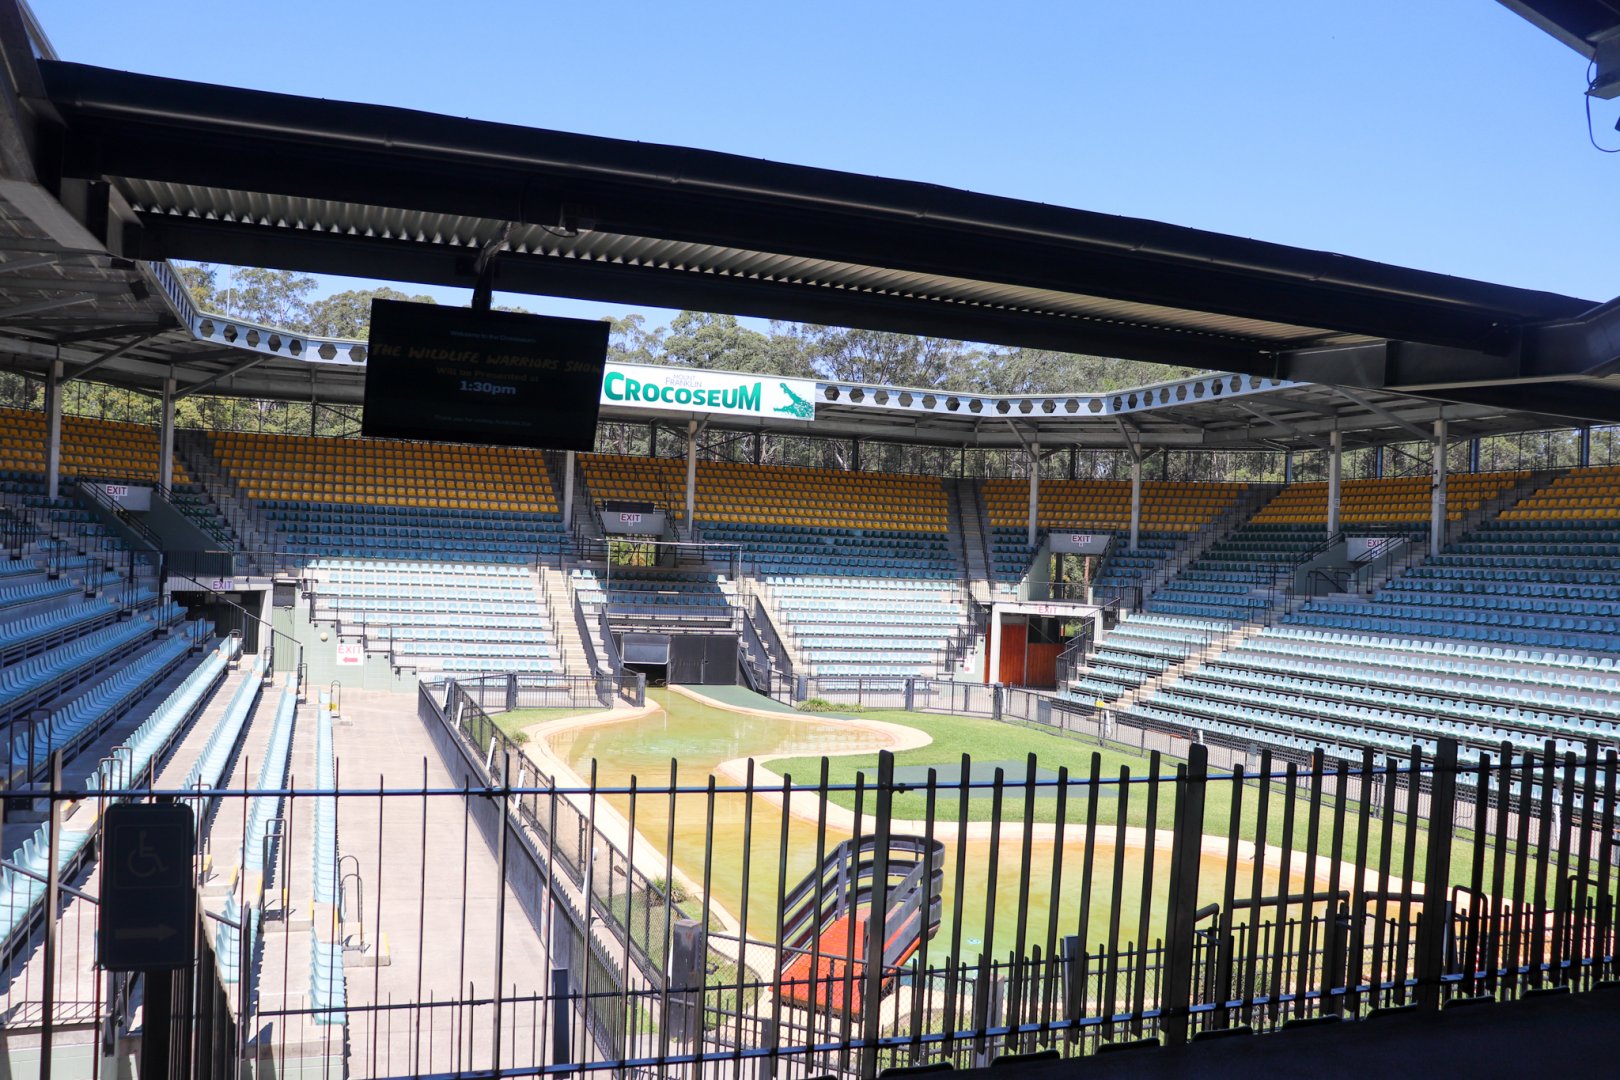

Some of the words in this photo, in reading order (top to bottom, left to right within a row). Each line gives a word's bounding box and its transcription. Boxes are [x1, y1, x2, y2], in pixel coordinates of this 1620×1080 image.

[370, 342, 402, 358] THE
[407, 346, 480, 364] WILDLIFE
[485, 354, 560, 371] WARRIORS
[458, 379, 517, 396] 1:30pm
[665, 376, 703, 388] FRANKLIN
[603, 371, 762, 412] CROCOSEUM
[107, 485, 127, 496] EXIT
[621, 513, 641, 521] EXIT
[213, 580, 233, 590] EXIT
[1039, 606, 1057, 614] EXIT
[338, 645, 362, 654] EXIT
